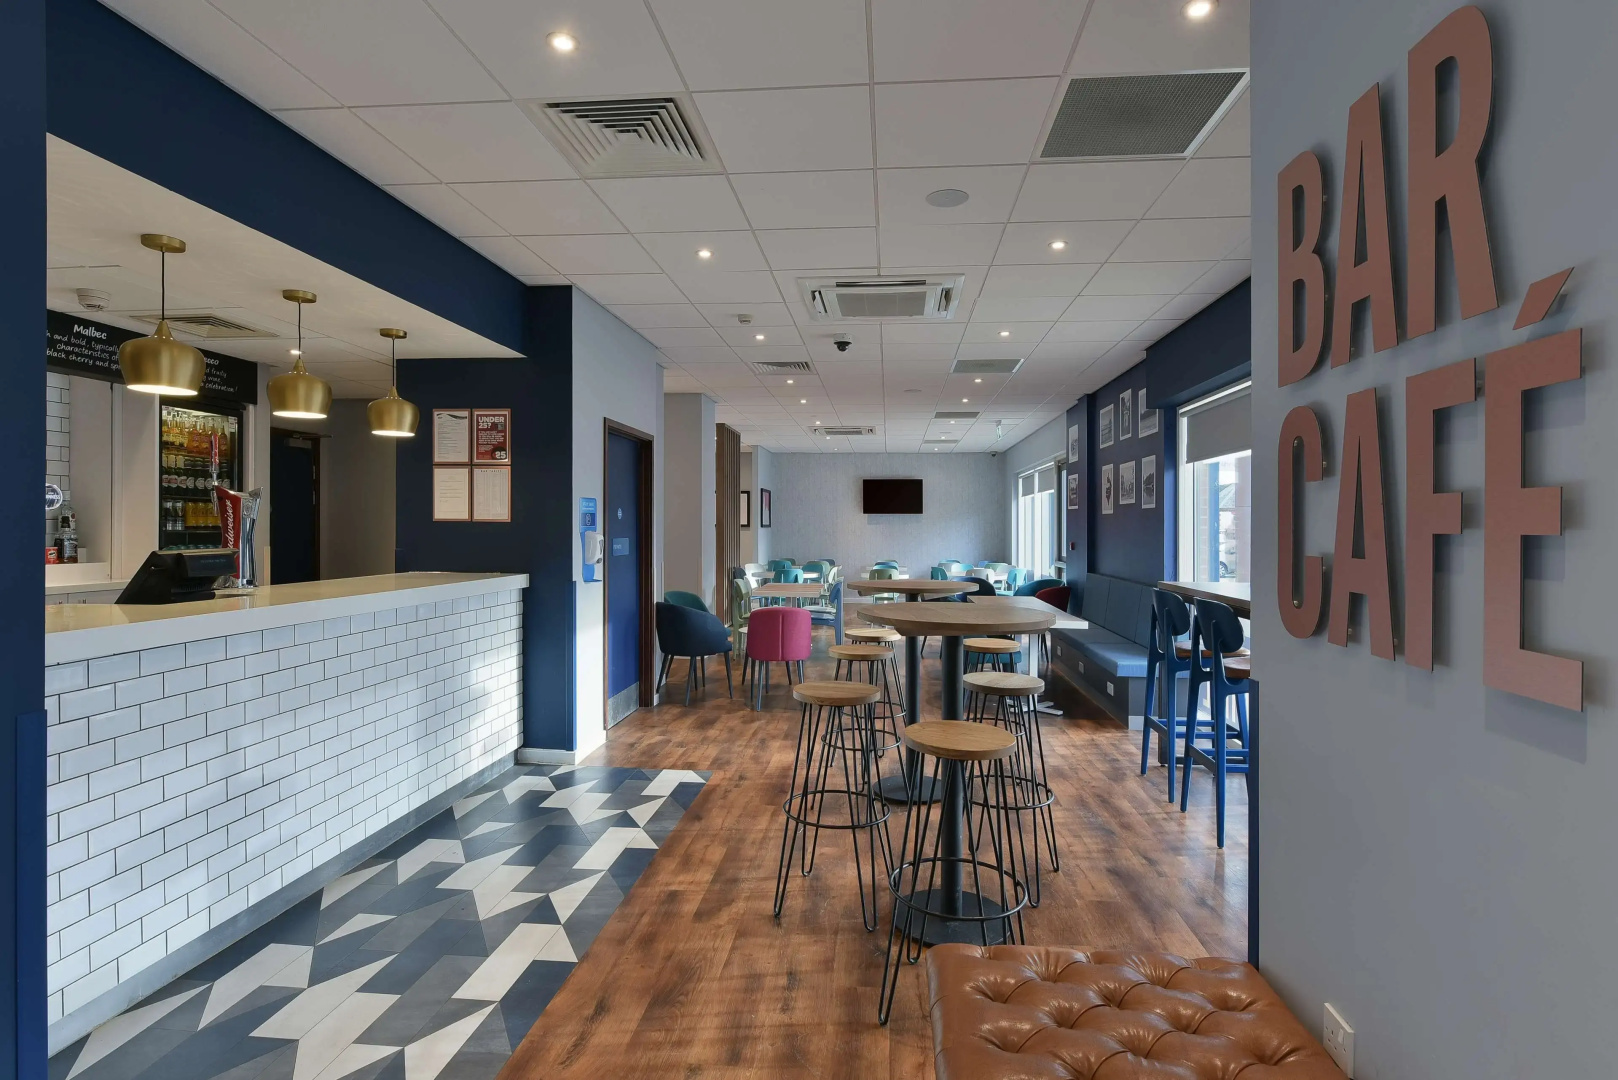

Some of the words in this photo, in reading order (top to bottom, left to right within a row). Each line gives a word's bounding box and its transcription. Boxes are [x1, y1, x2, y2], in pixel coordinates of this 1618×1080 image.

[1278, 5, 1499, 388] BAR
[53, 334, 68, 342] and
[74, 324, 107, 339] Malbec
[46, 347, 67, 359] black
[69, 353, 93, 366] cherry
[95, 359, 109, 368] and
[57, 343, 109, 359] characteristics
[496, 450, 507, 459] 25
[1277, 267, 1583, 712] CAFÉ
[224, 499, 235, 549] udweiser
